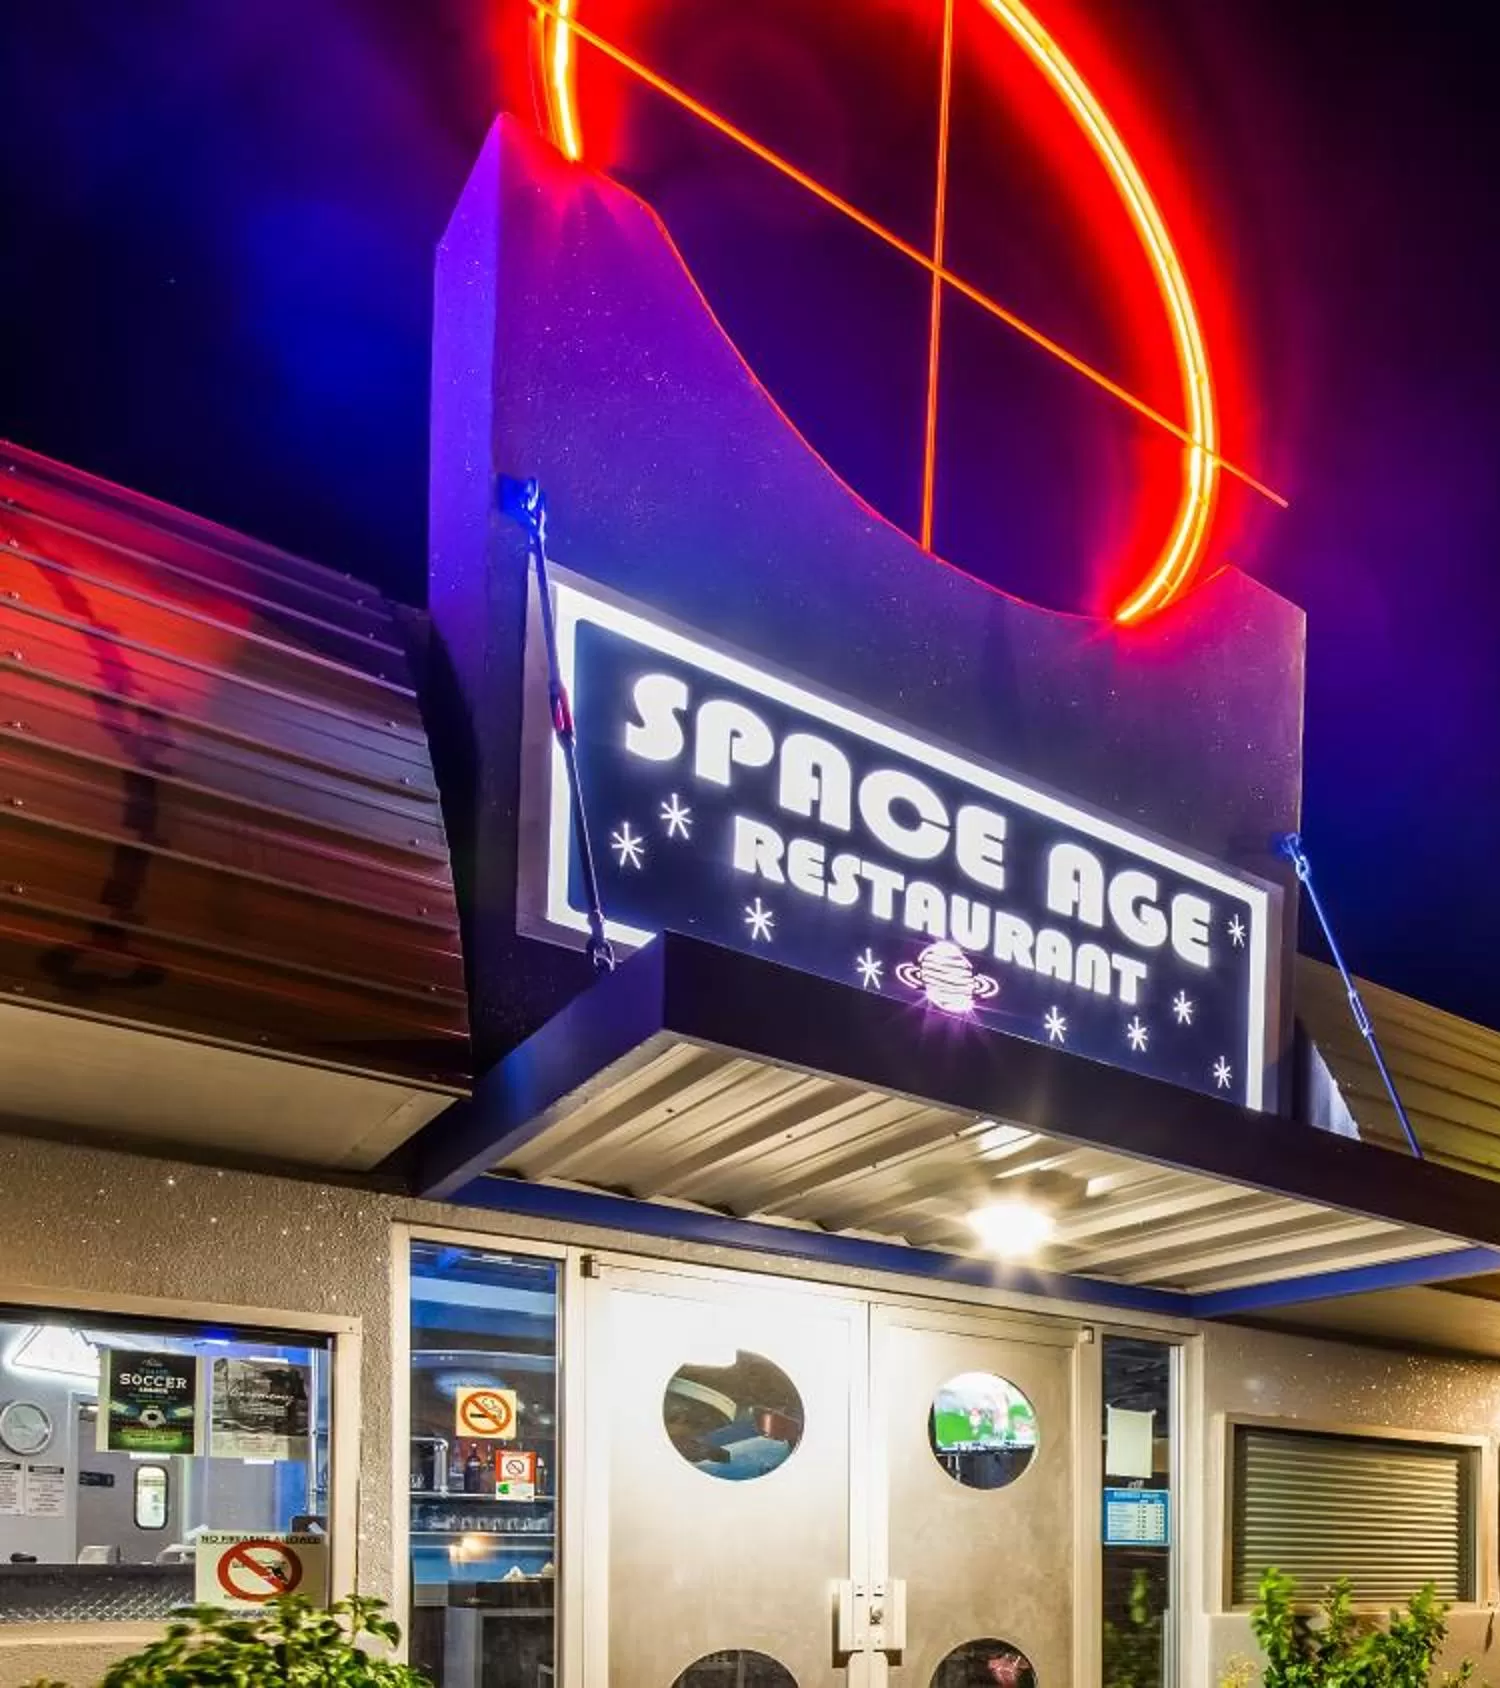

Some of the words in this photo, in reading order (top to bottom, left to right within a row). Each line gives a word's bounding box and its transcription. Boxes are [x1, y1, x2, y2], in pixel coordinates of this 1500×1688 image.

[625, 673, 1007, 889] SPACE
[1048, 843, 1212, 967] AGE
[734, 815, 1148, 1005] RESTAURANT
[119, 1373, 187, 1389] SOCCER
